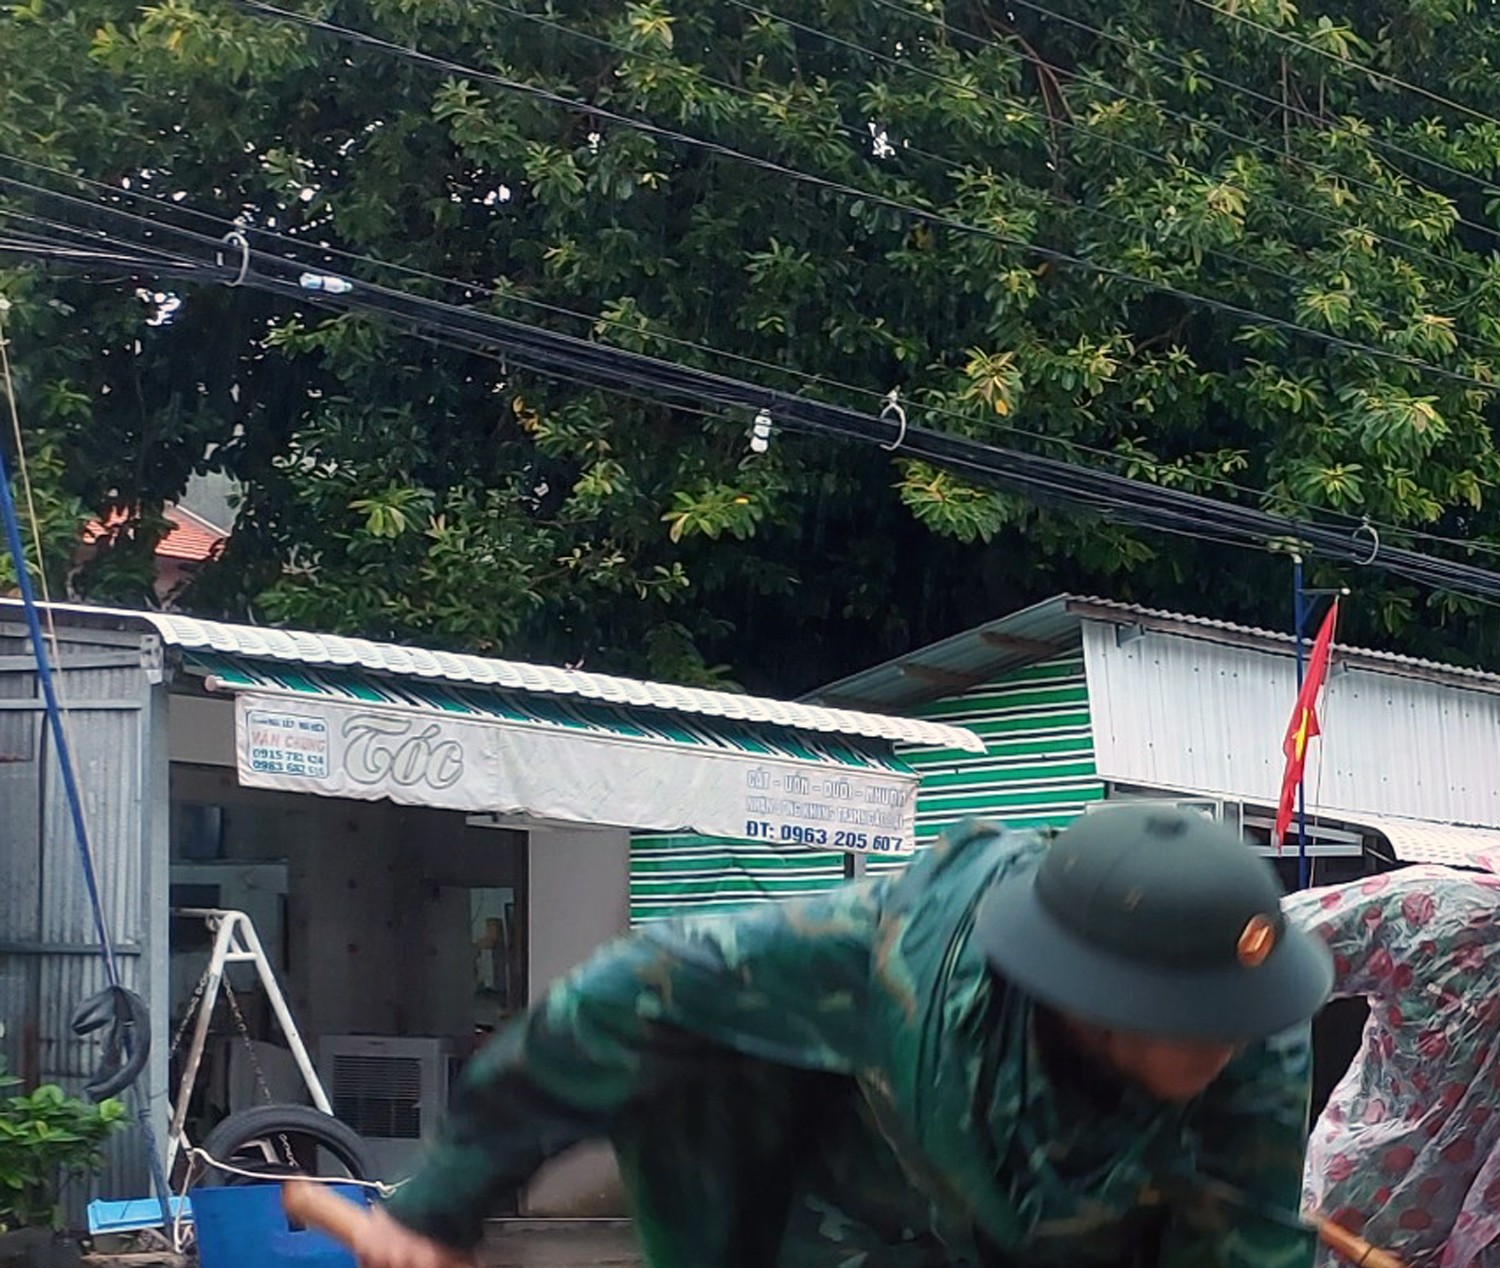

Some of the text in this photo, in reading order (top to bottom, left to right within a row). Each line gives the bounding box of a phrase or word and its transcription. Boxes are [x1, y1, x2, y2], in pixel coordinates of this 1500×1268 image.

[342, 714, 464, 790] Tóc
[746, 820, 775, 838] ĐT:
[780, 823, 828, 846] 0963
[834, 830, 868, 850] 205
